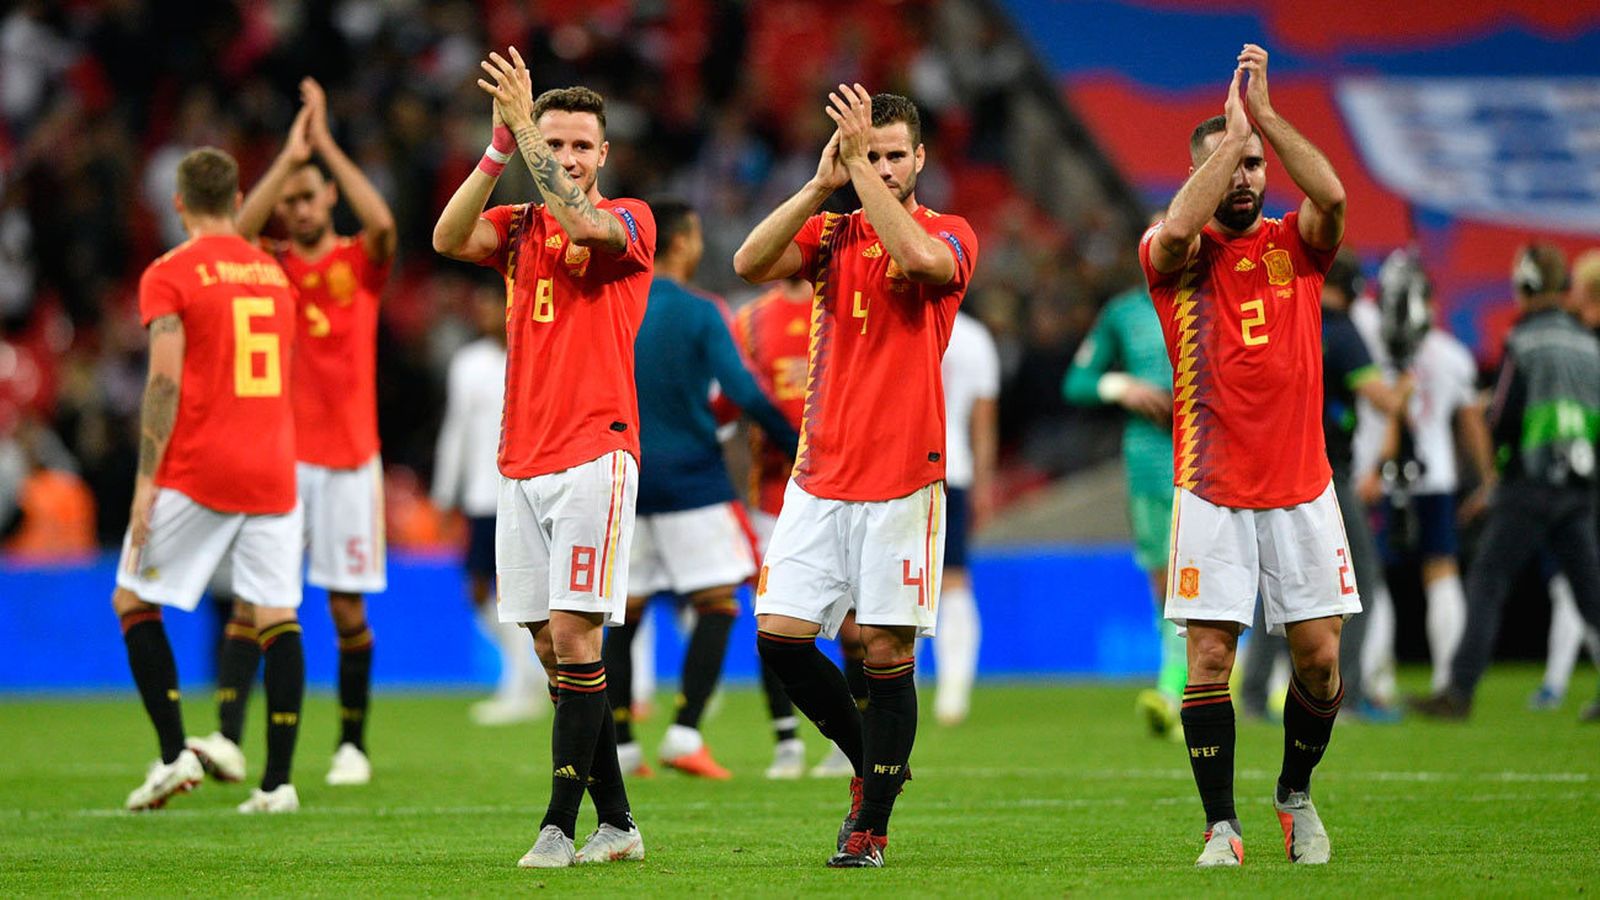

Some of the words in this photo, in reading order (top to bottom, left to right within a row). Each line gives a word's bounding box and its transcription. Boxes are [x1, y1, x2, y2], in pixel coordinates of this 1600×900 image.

[532, 277, 555, 323] 8
[852, 291, 871, 335] 4
[1240, 298, 1269, 346] 2
[232, 296, 282, 398] 6
[345, 536, 368, 577] 5
[569, 545, 596, 593] 8
[1336, 548, 1355, 596] 2
[902, 559, 925, 607] 4
